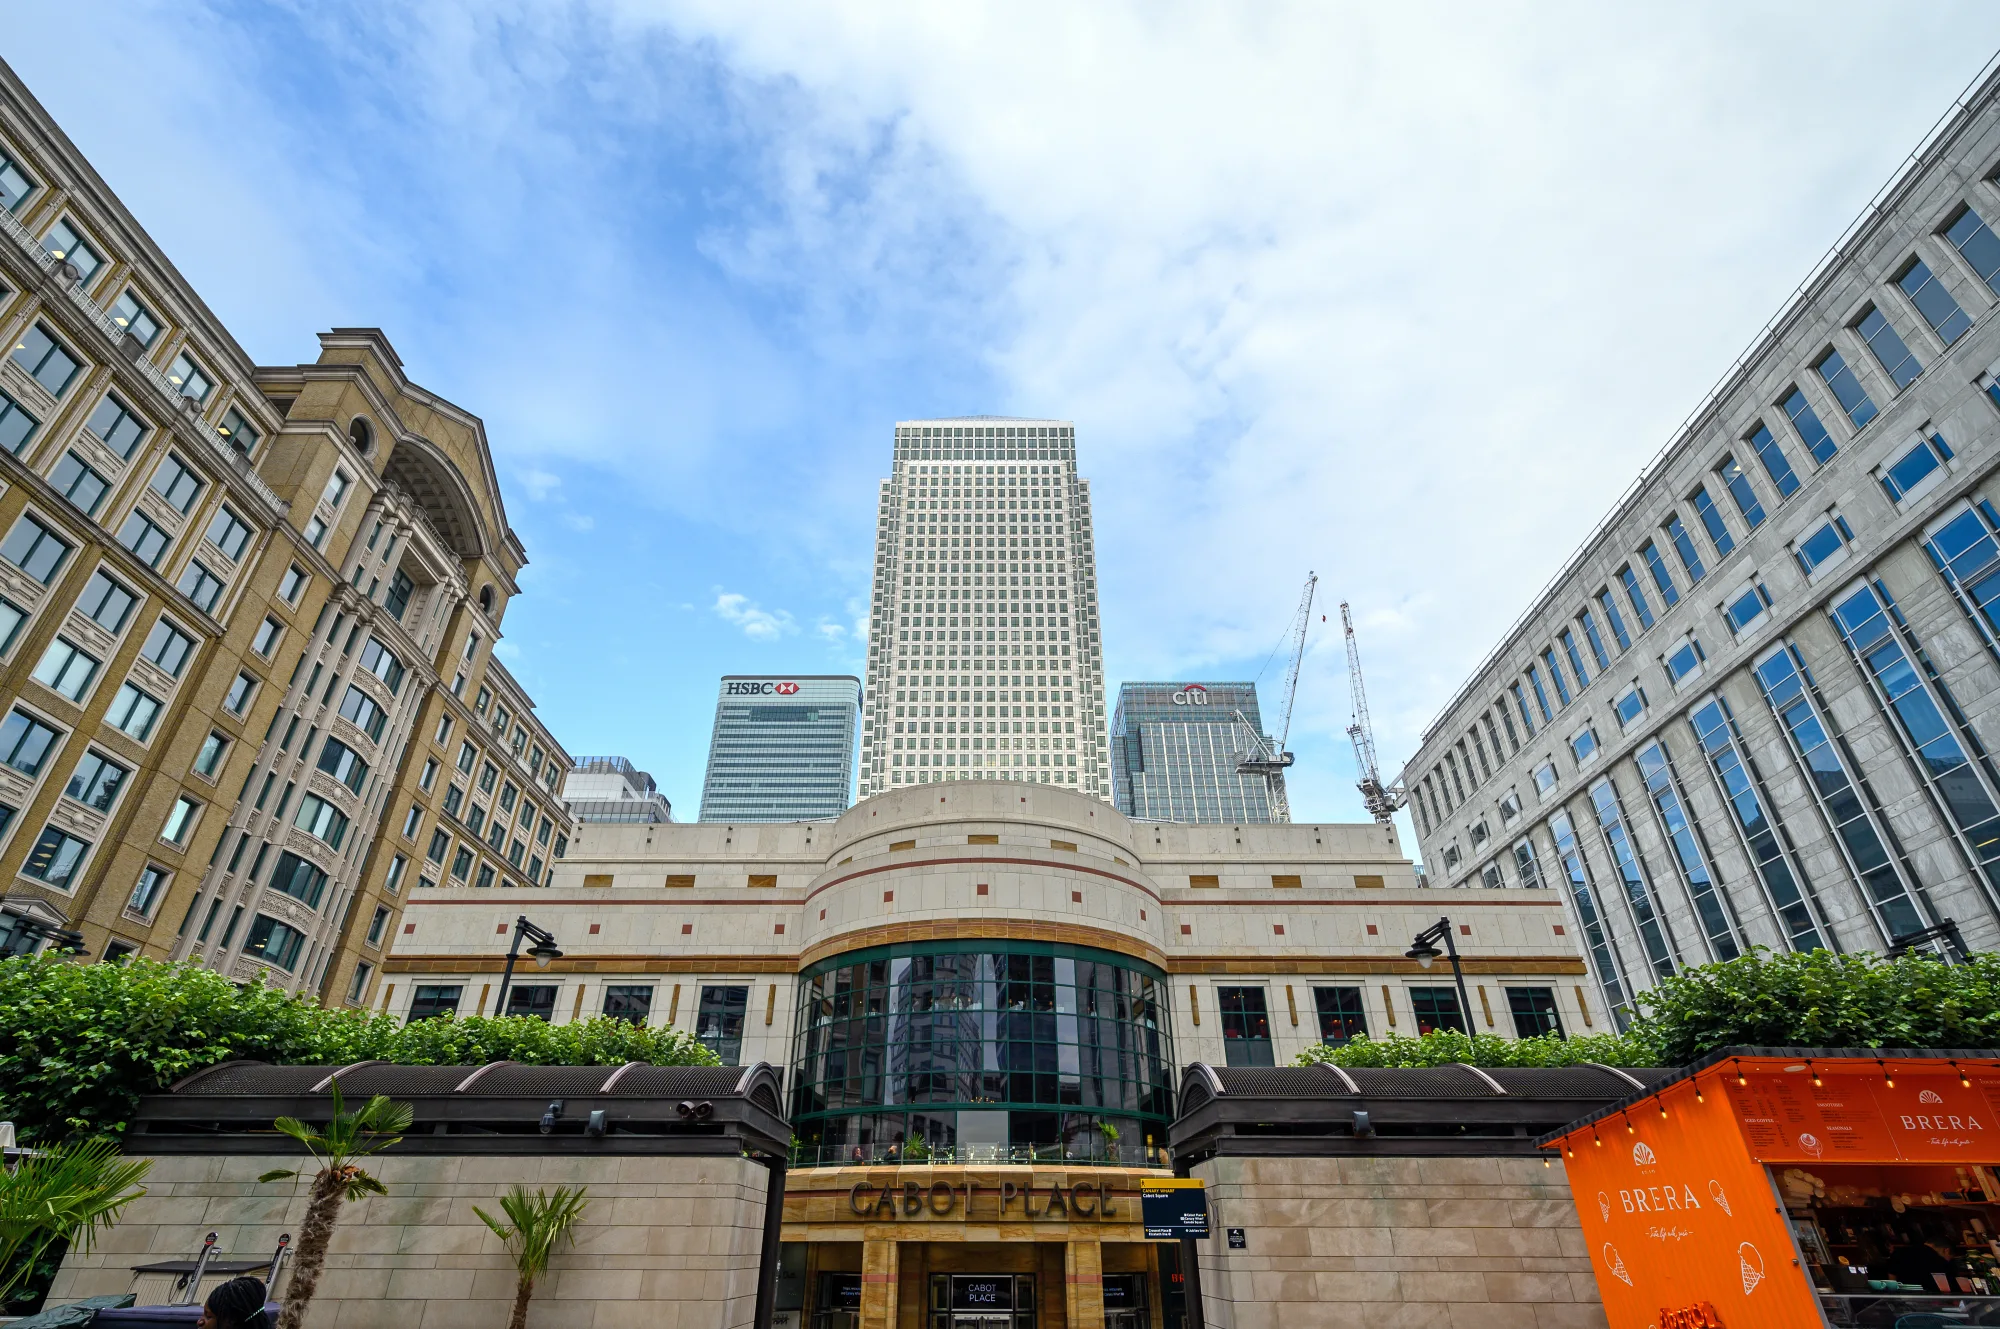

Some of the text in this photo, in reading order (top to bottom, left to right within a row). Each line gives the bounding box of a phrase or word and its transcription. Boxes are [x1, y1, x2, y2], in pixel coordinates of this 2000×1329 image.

[726, 682, 774, 695] HSBC
[1172, 687, 1208, 705] citi
[1900, 1115, 1984, 1130] BRERA
[850, 1181, 1117, 1217] CABOT PLACE
[1619, 1184, 1702, 1213] BRERA
[968, 1284, 996, 1292] CABOT
